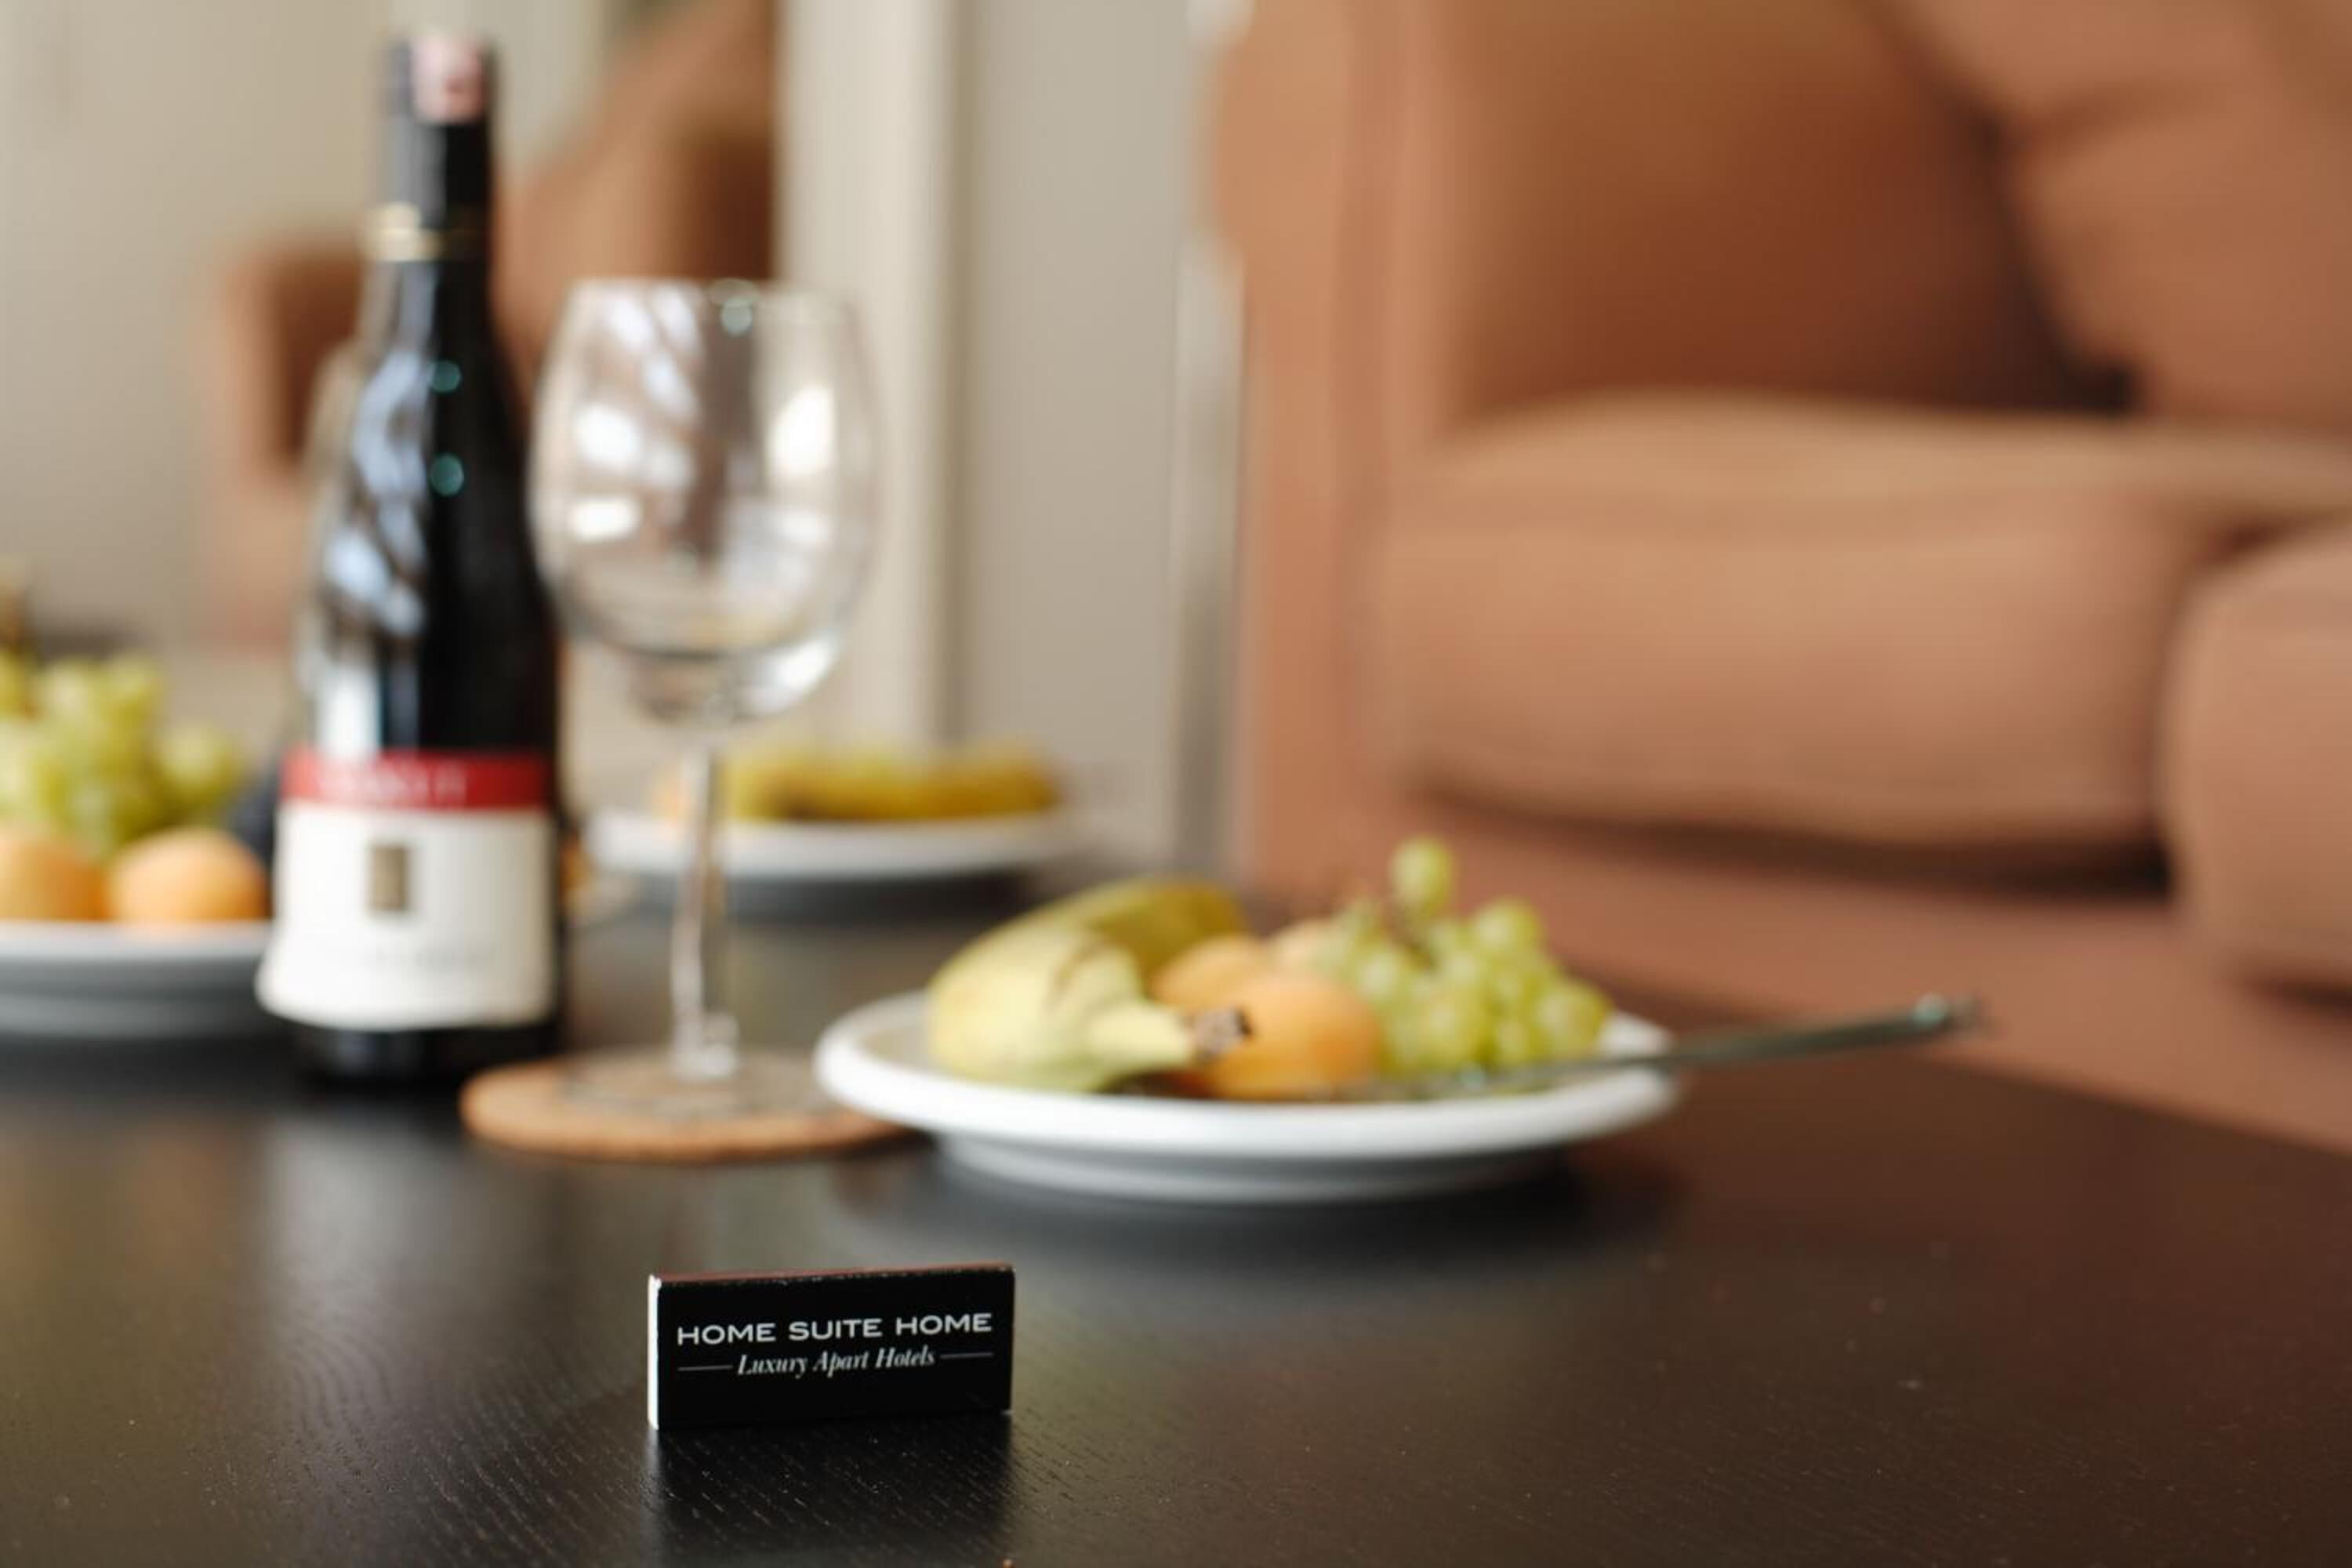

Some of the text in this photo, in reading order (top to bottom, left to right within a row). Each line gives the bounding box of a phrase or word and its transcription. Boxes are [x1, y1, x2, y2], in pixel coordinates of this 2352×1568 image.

[677, 1312, 993, 1345] HOME SUITE HOME
[737, 1345, 936, 1379] Luxury Apart Hotels
